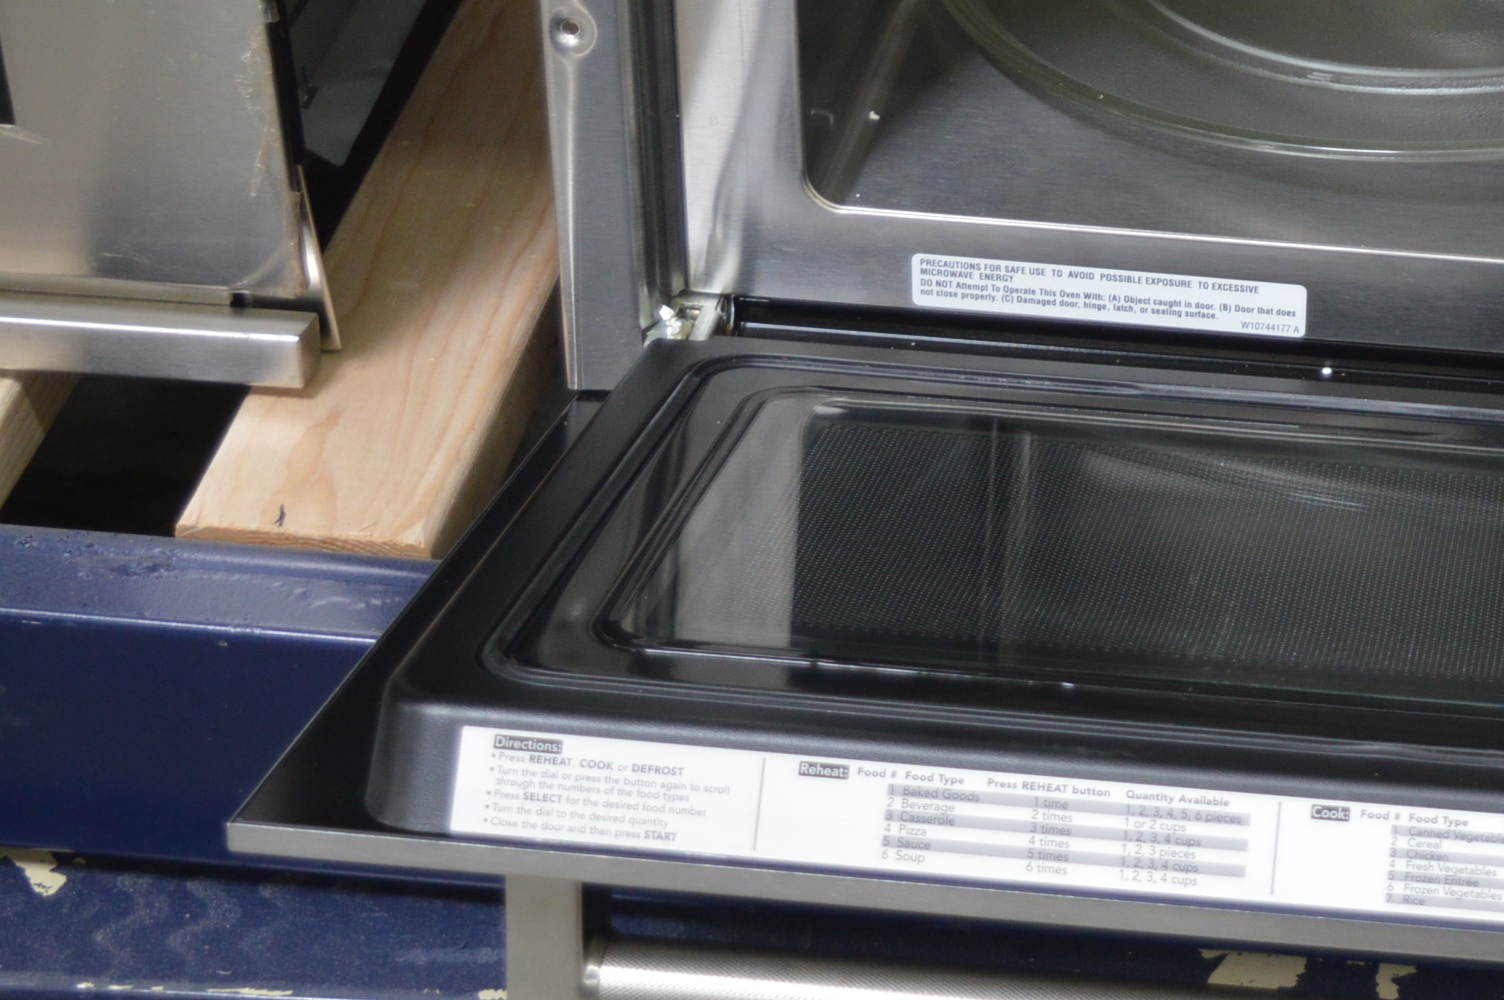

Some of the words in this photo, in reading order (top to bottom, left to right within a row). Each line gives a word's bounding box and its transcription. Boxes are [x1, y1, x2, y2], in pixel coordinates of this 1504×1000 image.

[920, 268, 974, 279] MICROWAVE
[979, 273, 1014, 283] ENERGY
[920, 258, 981, 271] PRECAUTIONS
[984, 263, 1002, 273] FOR
[1004, 265, 1026, 275] SAFE
[1029, 267, 1047, 276] USE
[1051, 269, 1063, 278] TO
[1068, 270, 1095, 280] AVOID
[1100, 273, 1143, 285] POSSIBLE
[1145, 276, 1193, 289] EXPOSURE
[1198, 281, 1209, 290] TO
[1211, 282, 1260, 294] EXCESSIVE
[920, 278, 933, 287] DO
[935, 280, 953, 289] NOT
[956, 281, 989, 293] Attempt
[991, 283, 1001, 292] To
[1003, 284, 1036, 296] Operate
[1039, 287, 1057, 297] This
[1059, 289, 1081, 299] Oven
[1108, 294, 1121, 304] (A)
[1123, 295, 1151, 306] Object
[1153, 297, 1182, 309] caught
[1184, 300, 1192, 308] in
[1195, 300, 1216, 310] door.
[1219, 303, 1232, 313] (B)
[1234, 304, 1254, 313] Door
[1256, 306, 1274, 315] that
[1275, 308, 1297, 317] does
[920, 288, 933, 296] not
[936, 289, 958, 298] close
[1001, 293, 1014, 304] (C)
[1017, 295, 1056, 307] Damaged
[1139, 306, 1149, 314] or
[1151, 306, 1181, 318] sealing
[1184, 309, 1219, 320] surface.
[1240, 321, 1291, 333] W10744177
[495, 735, 562, 752] Directions:
[498, 751, 525, 763] Press
[579, 758, 613, 771] COOK
[617, 763, 627, 771] or
[631, 763, 684, 777] DEFROST
[800, 762, 848, 779] Reheat:
[857, 766, 886, 778] Food
[905, 771, 934, 783] Food
[938, 773, 965, 786] Type
[987, 778, 1017, 790] Press
[1021, 780, 1068, 794] REHEAT
[1072, 784, 1110, 798] button
[1126, 789, 1175, 804] Quantity
[1178, 794, 1229, 808] Available
[903, 785, 938, 799] Baked
[942, 789, 980, 802] Goods
[494, 789, 520, 800] Press
[522, 791, 563, 804] SELECT
[566, 794, 580, 805] for
[583, 796, 599, 807] the
[602, 797, 639, 811] desired
[642, 800, 666, 813] food
[668, 804, 707, 817] number
[902, 798, 955, 814] Beverage
[900, 811, 955, 826] Casserole
[1312, 806, 1350, 821] Cook:
[1360, 809, 1390, 820] Food
[1409, 813, 1438, 825] Food
[1441, 815, 1469, 828] Type
[899, 824, 927, 837] Pizza
[896, 837, 931, 850] Sauce
[895, 850, 925, 863] Soup
